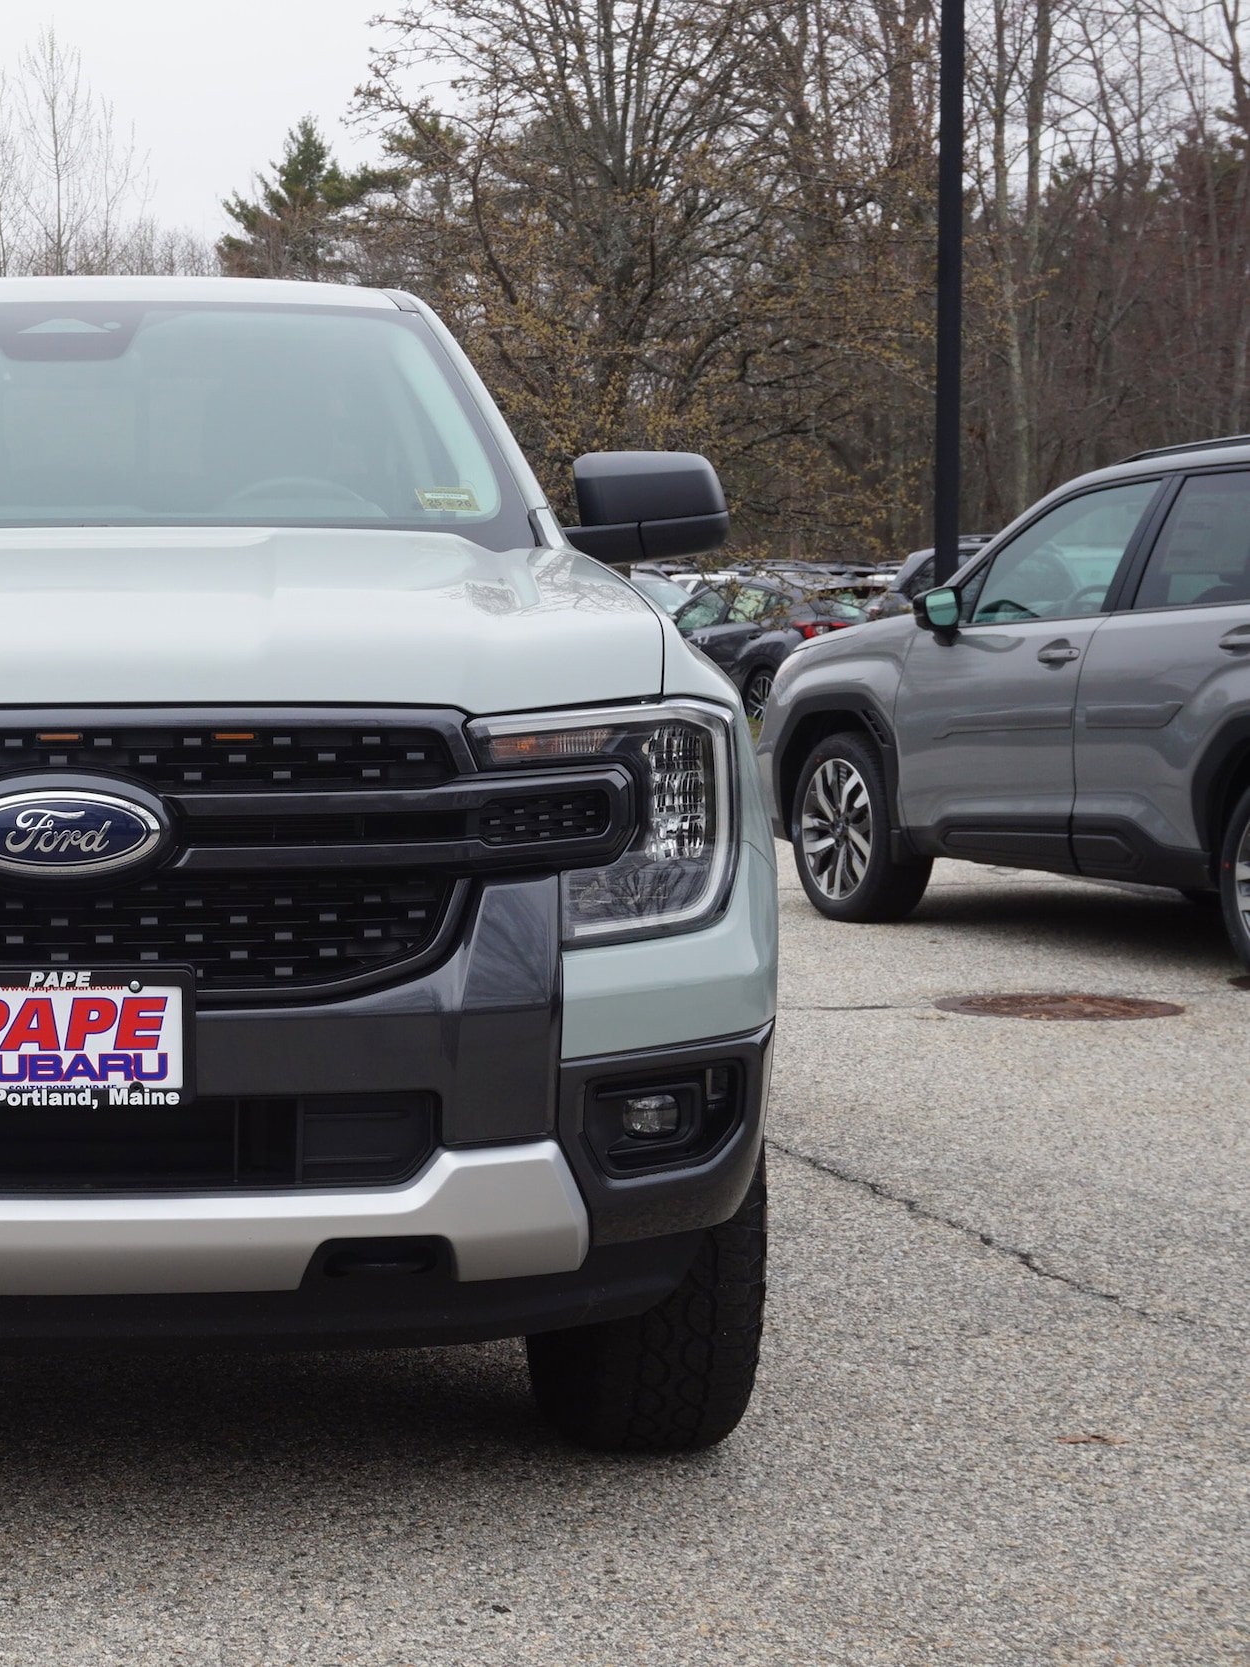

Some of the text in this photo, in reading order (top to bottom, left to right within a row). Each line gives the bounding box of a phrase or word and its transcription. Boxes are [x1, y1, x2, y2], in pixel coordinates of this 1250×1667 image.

[5, 808, 112, 853] Ford
[28, 971, 92, 987] PAPE
[108, 1088, 181, 1106] Maine
